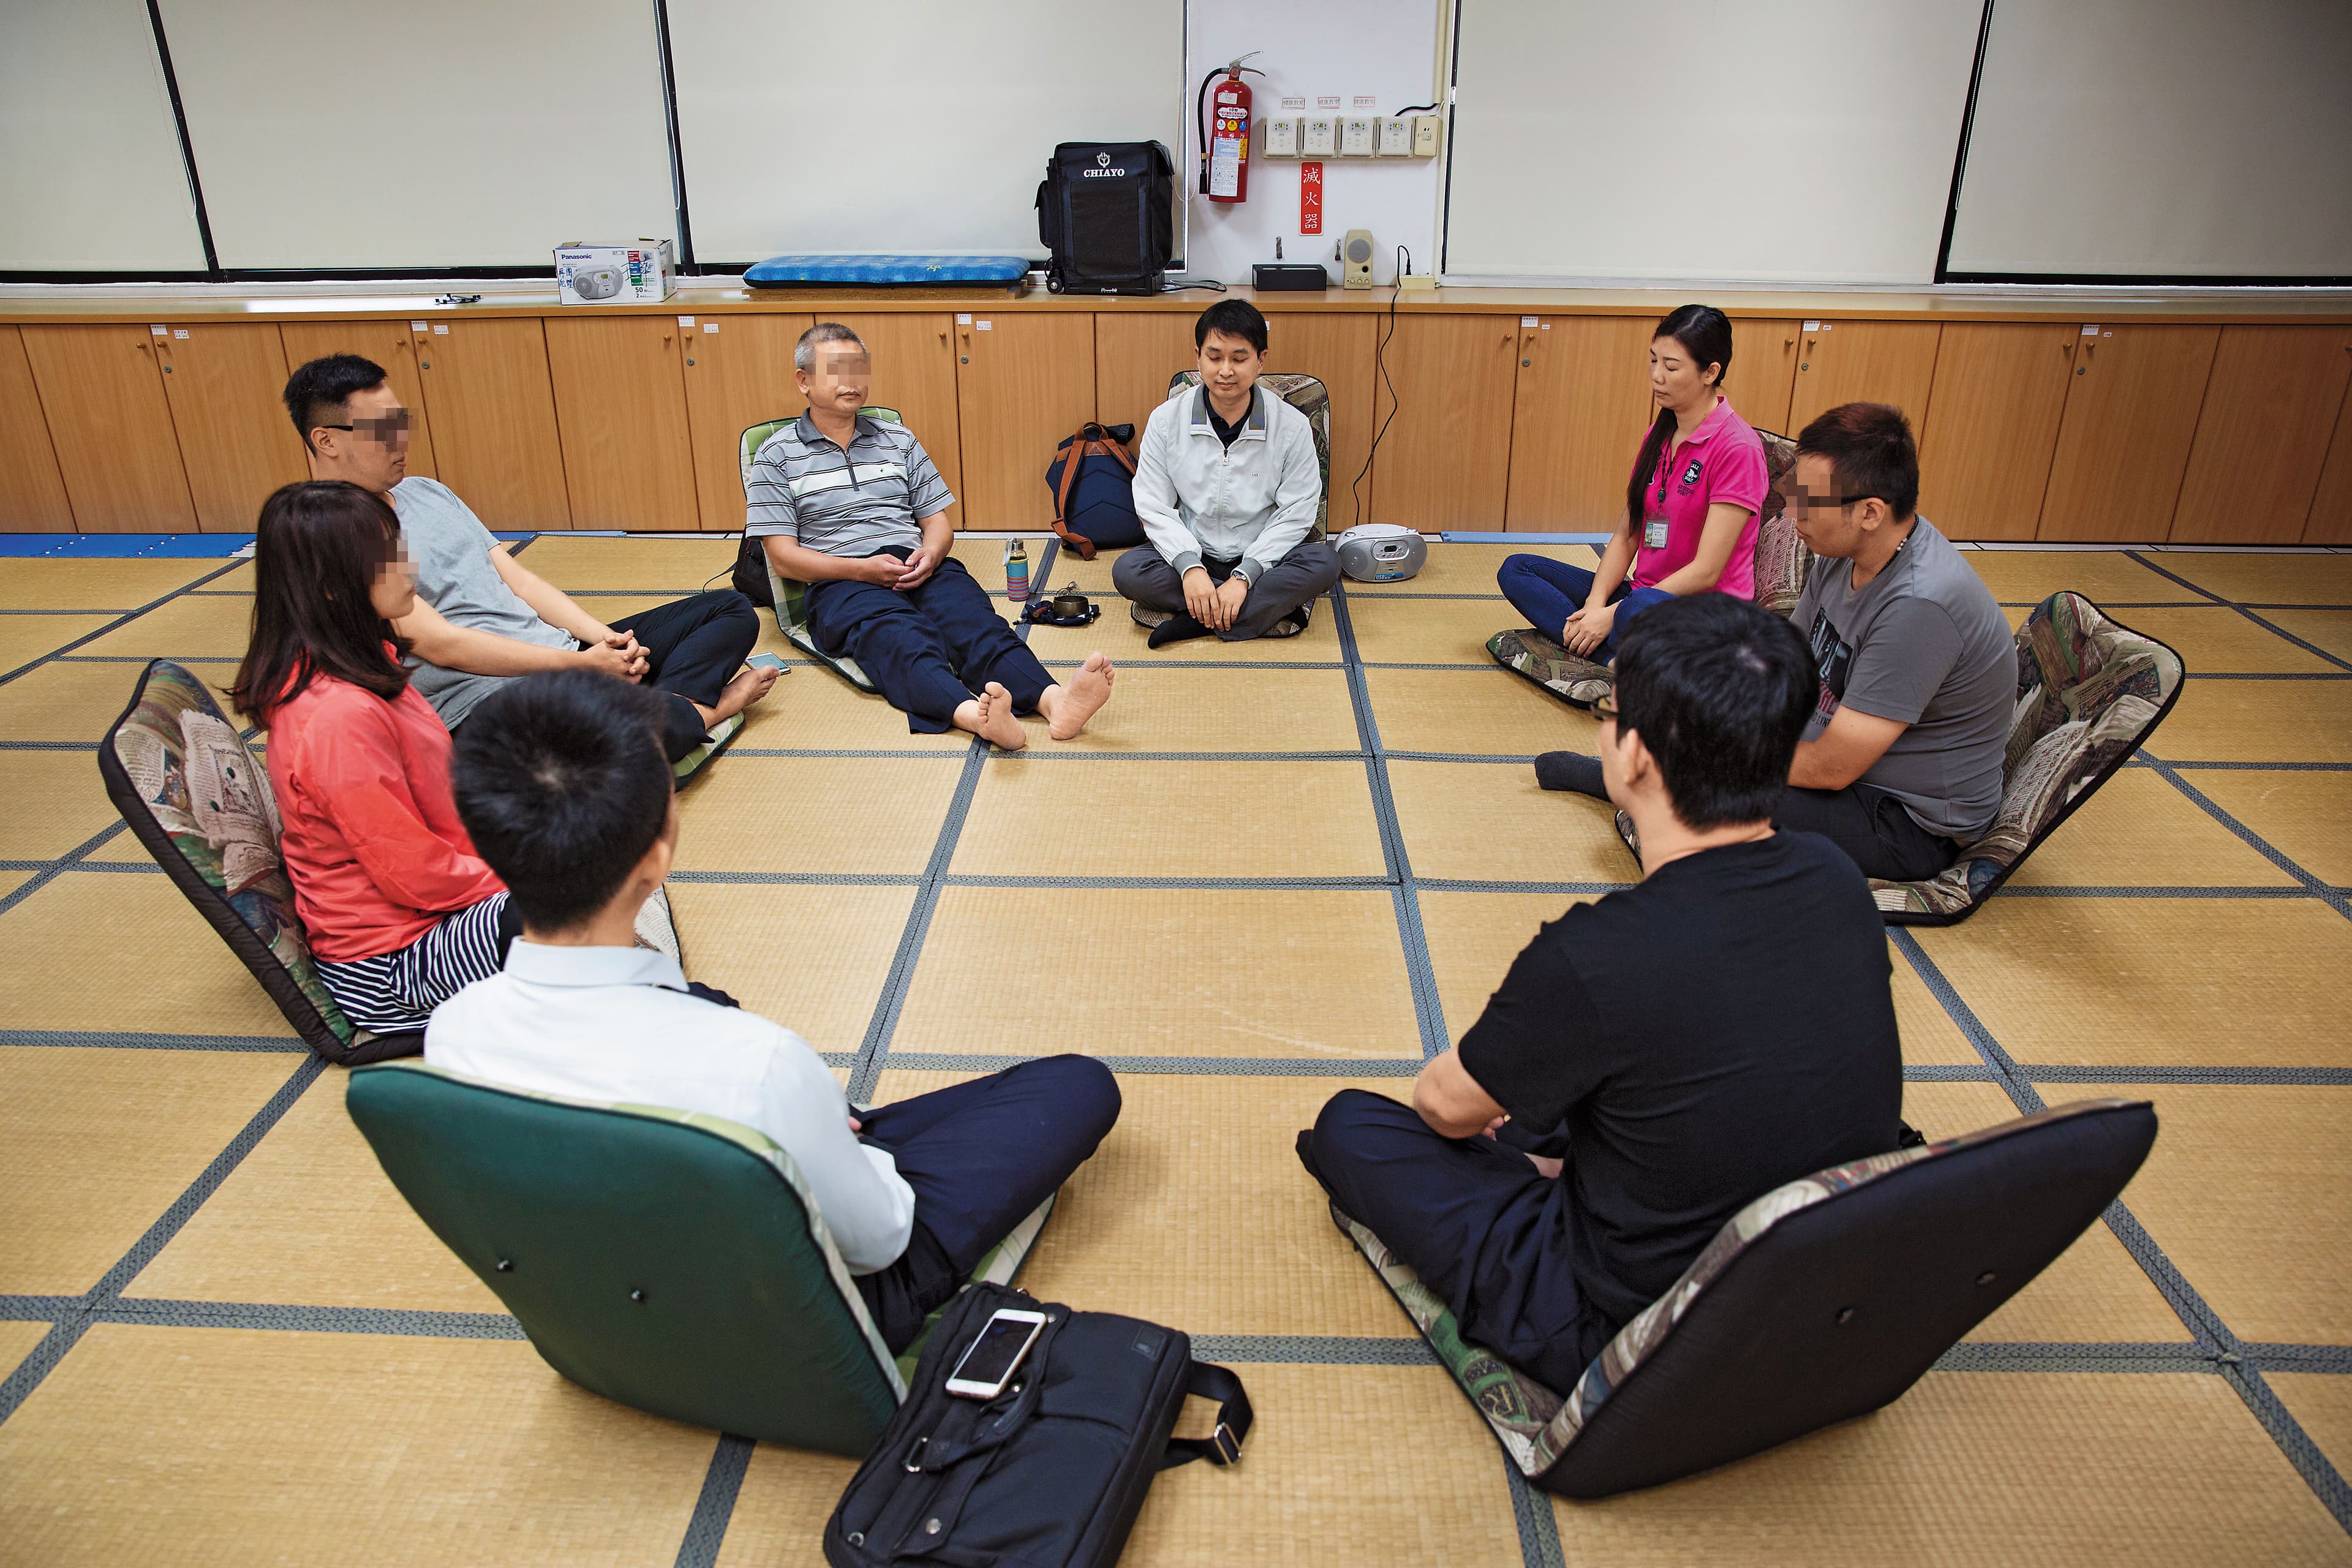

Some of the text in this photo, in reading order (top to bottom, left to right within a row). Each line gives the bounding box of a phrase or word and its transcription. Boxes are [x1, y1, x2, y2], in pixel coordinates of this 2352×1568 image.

[1083, 168, 1125, 178] CHIAYO
[1303, 167, 1321, 229] 滅火器
